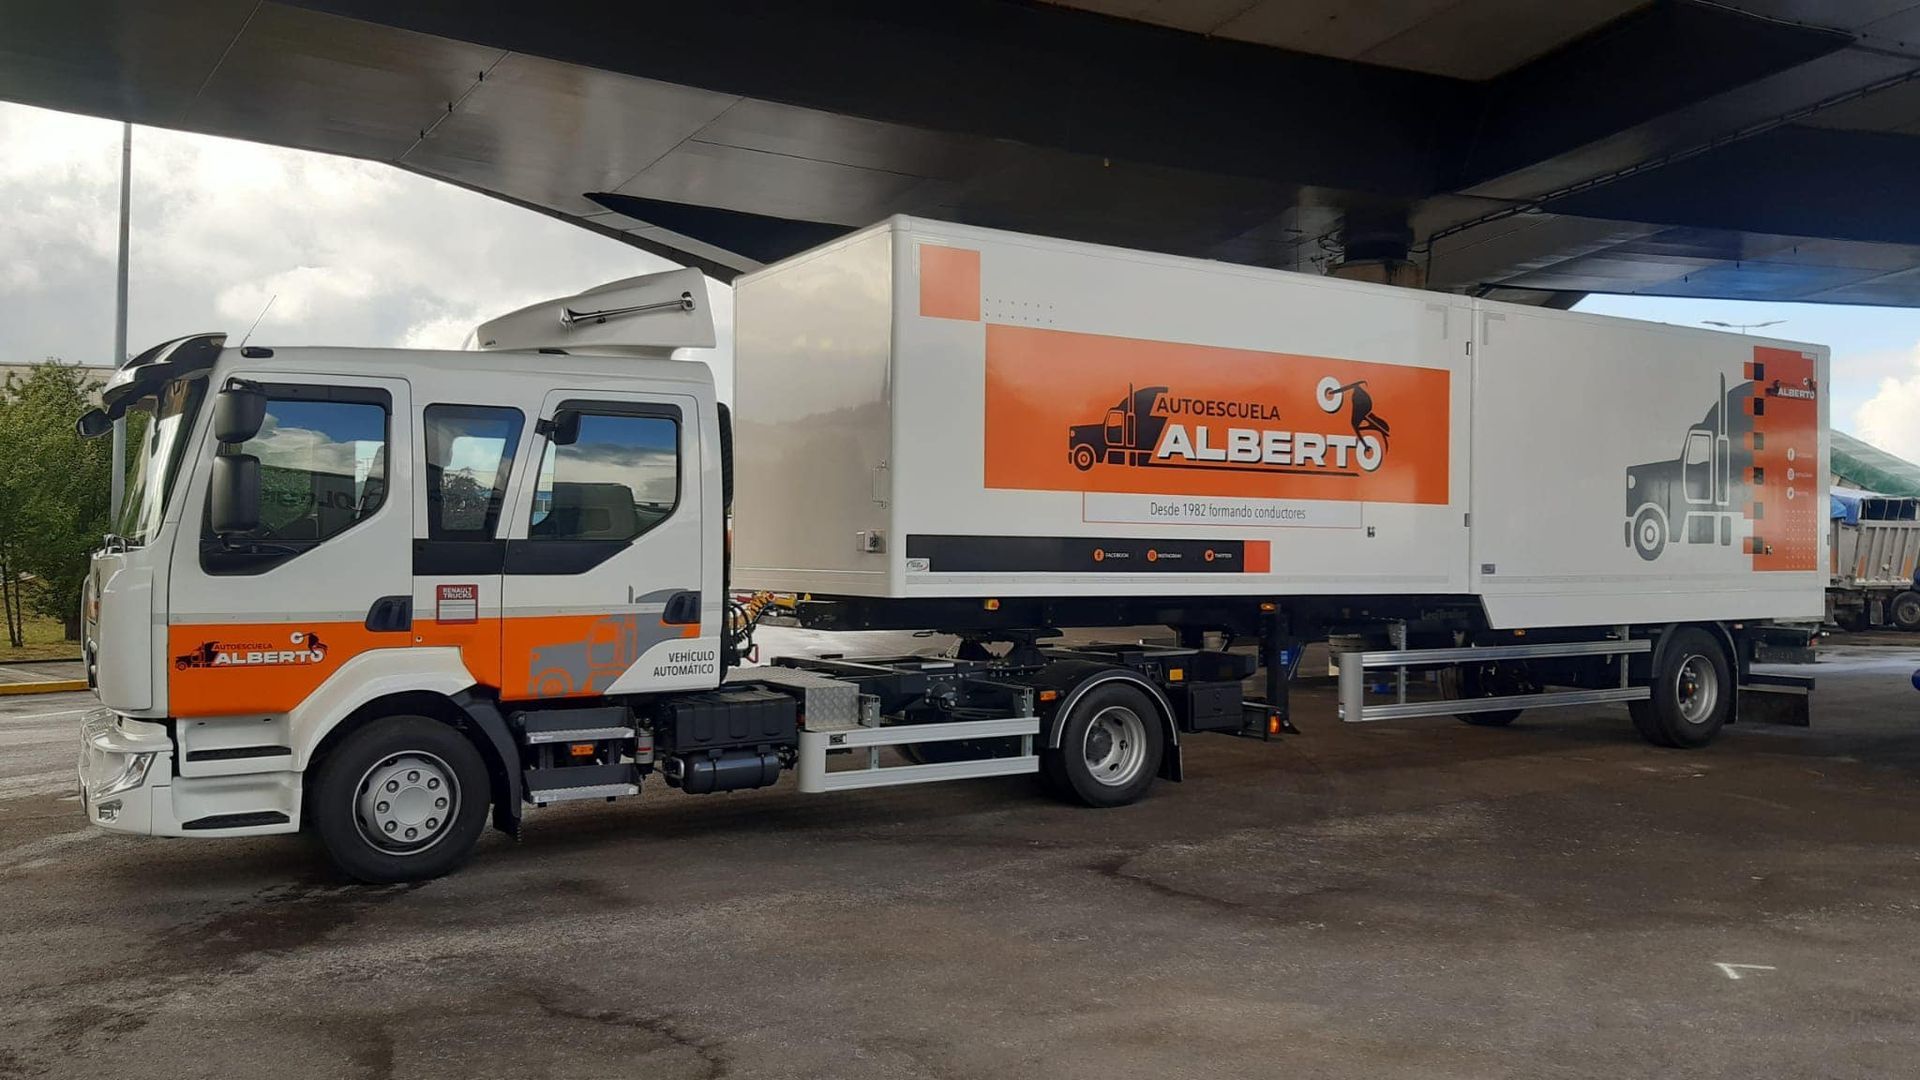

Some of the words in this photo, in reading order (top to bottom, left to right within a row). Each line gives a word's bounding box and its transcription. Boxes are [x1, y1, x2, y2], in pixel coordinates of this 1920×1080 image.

[1777, 387, 1815, 400] ALBERTO
[1156, 397, 1281, 420] AUTOESCUELA
[1157, 424, 1383, 471] ALBERTO
[1150, 502, 1180, 516] Desde
[1182, 503, 1206, 517] 1982
[1208, 504, 1253, 519] formando
[1254, 507, 1306, 520] conductores
[214, 650, 324, 663] ALBERTO
[668, 649, 715, 662] VEHÍCULO
[653, 663, 714, 677] AUTOMÁTICO
